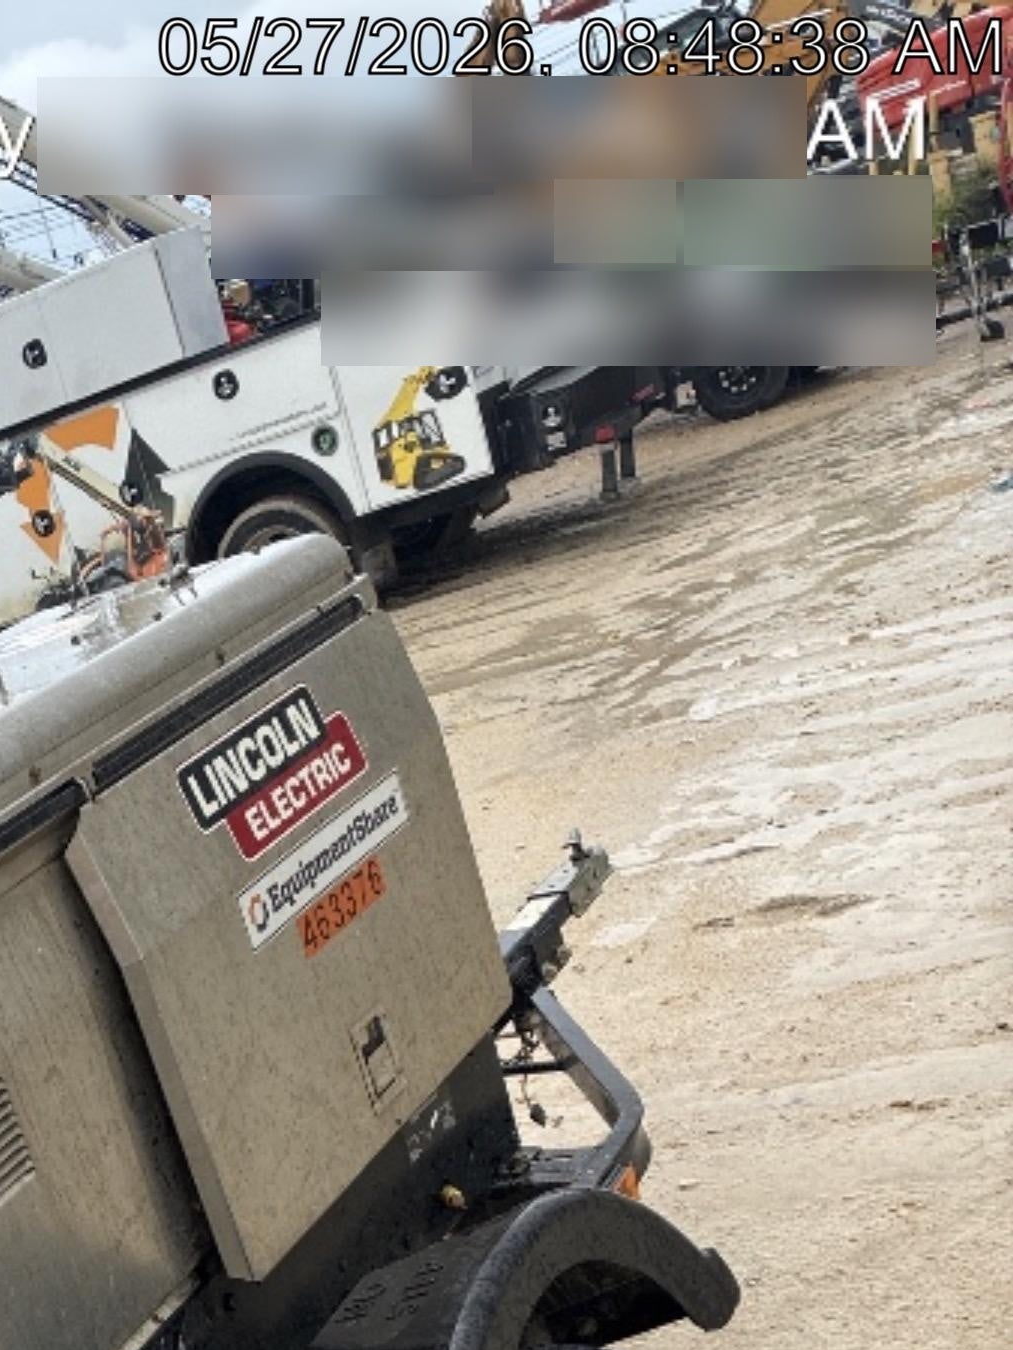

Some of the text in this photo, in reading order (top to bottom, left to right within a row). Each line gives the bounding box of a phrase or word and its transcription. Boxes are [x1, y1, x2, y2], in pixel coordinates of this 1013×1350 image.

[187, 698, 321, 818] LINCOLN
[244, 743, 352, 841] ELECTRIC
[267, 796, 399, 912] EquipmentShare
[305, 861, 382, 949] 463376
